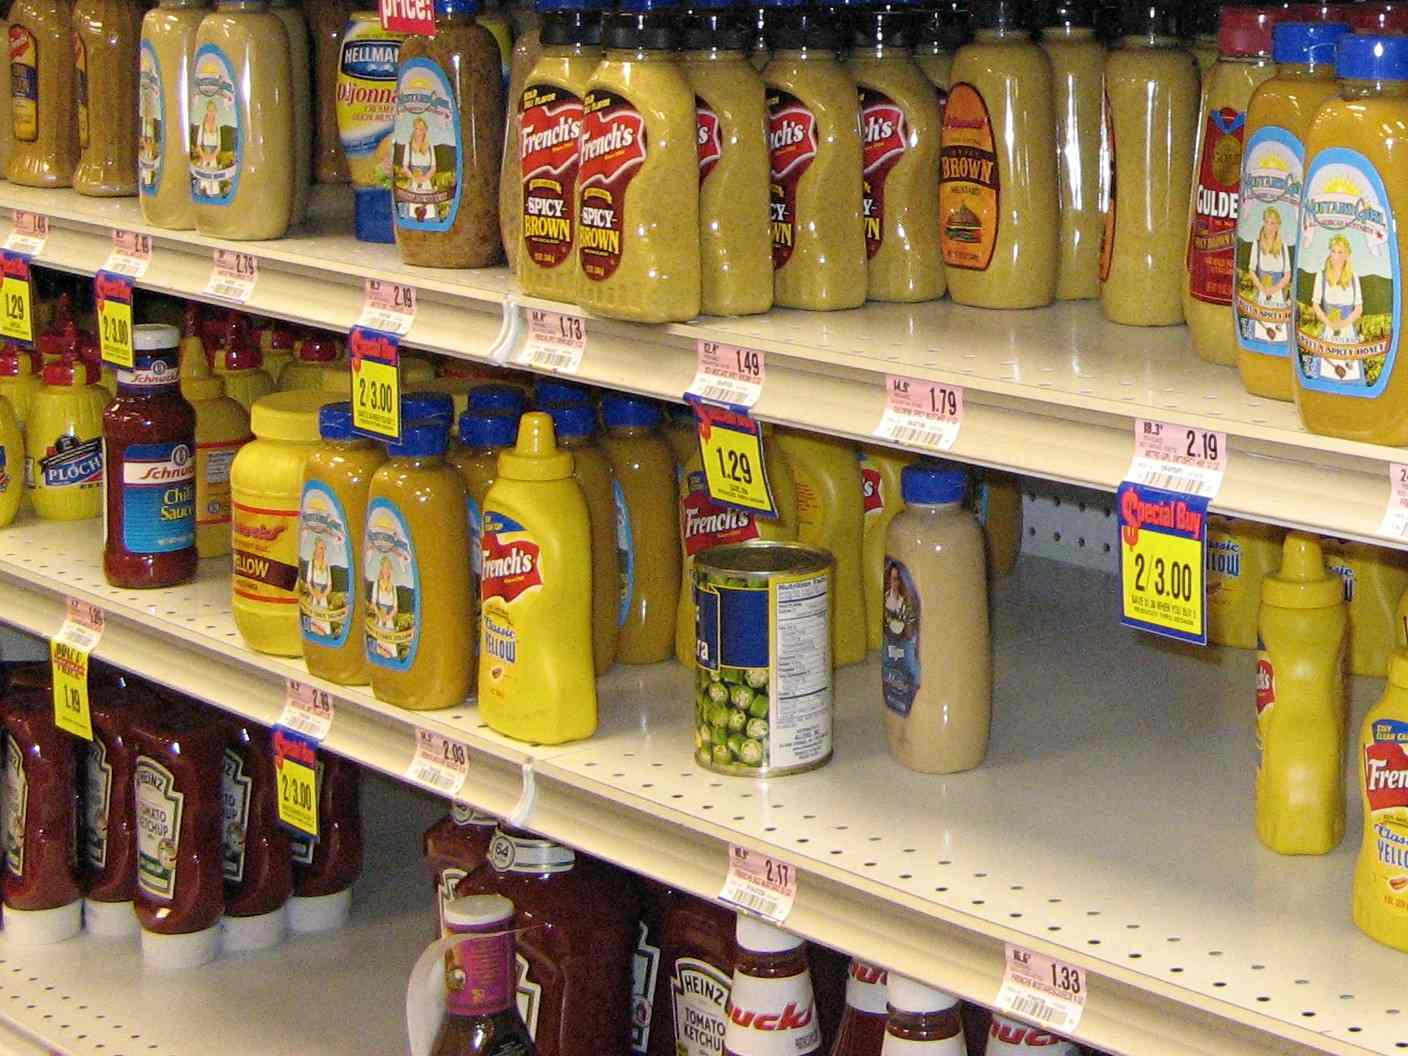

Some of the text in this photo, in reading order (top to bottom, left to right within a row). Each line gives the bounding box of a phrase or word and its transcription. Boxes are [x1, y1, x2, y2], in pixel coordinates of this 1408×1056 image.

[521, 117, 581, 158] French's
[942, 156, 992, 182] BROWN
[528, 197, 564, 217] SPICY
[583, 207, 615, 227] SPICY
[525, 216, 571, 242] BROWN
[559, 316, 583, 340] 1.73
[736, 348, 760, 376] 1.49
[358, 377, 393, 413] 2/3.00
[928, 385, 958, 415] 1.79
[1186, 430, 1218, 460] 2.19
[716, 447, 753, 484] 1.29
[1135, 553, 1192, 602] 2/3.00
[764, 858, 790, 889] 2.17
[684, 976, 724, 1006] HEINZ
[1049, 962, 1081, 994] 1.33
[685, 1007, 726, 1035] TOMATO
